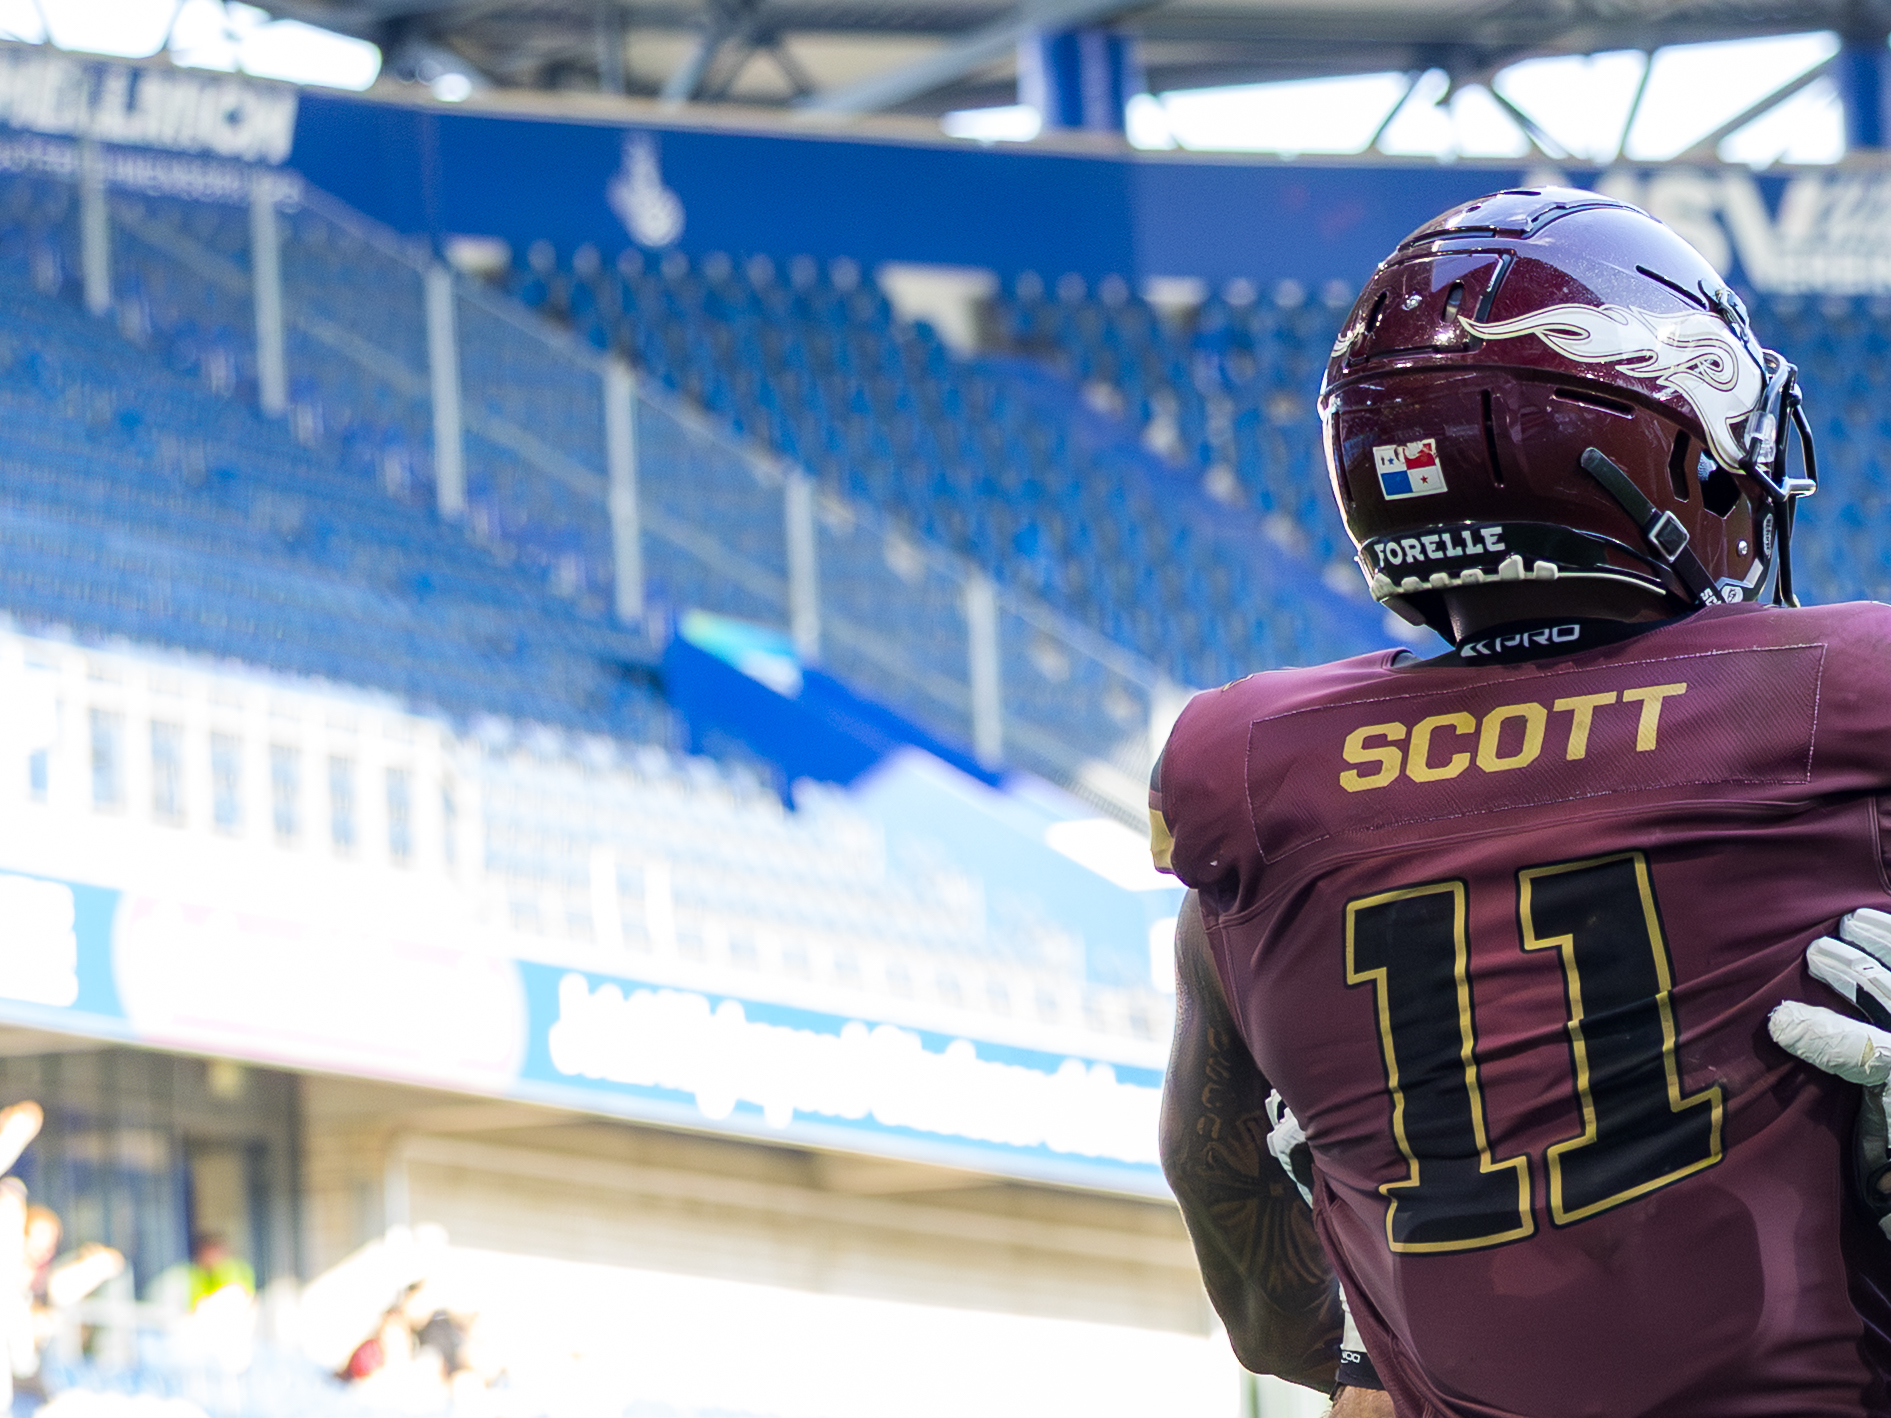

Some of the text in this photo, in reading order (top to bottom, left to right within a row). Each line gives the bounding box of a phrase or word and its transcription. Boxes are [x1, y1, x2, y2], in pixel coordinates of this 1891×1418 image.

[1374, 527, 1506, 568] FORELLE
[1340, 682, 1688, 793] SCOTT
[1343, 849, 1724, 1255] 11
